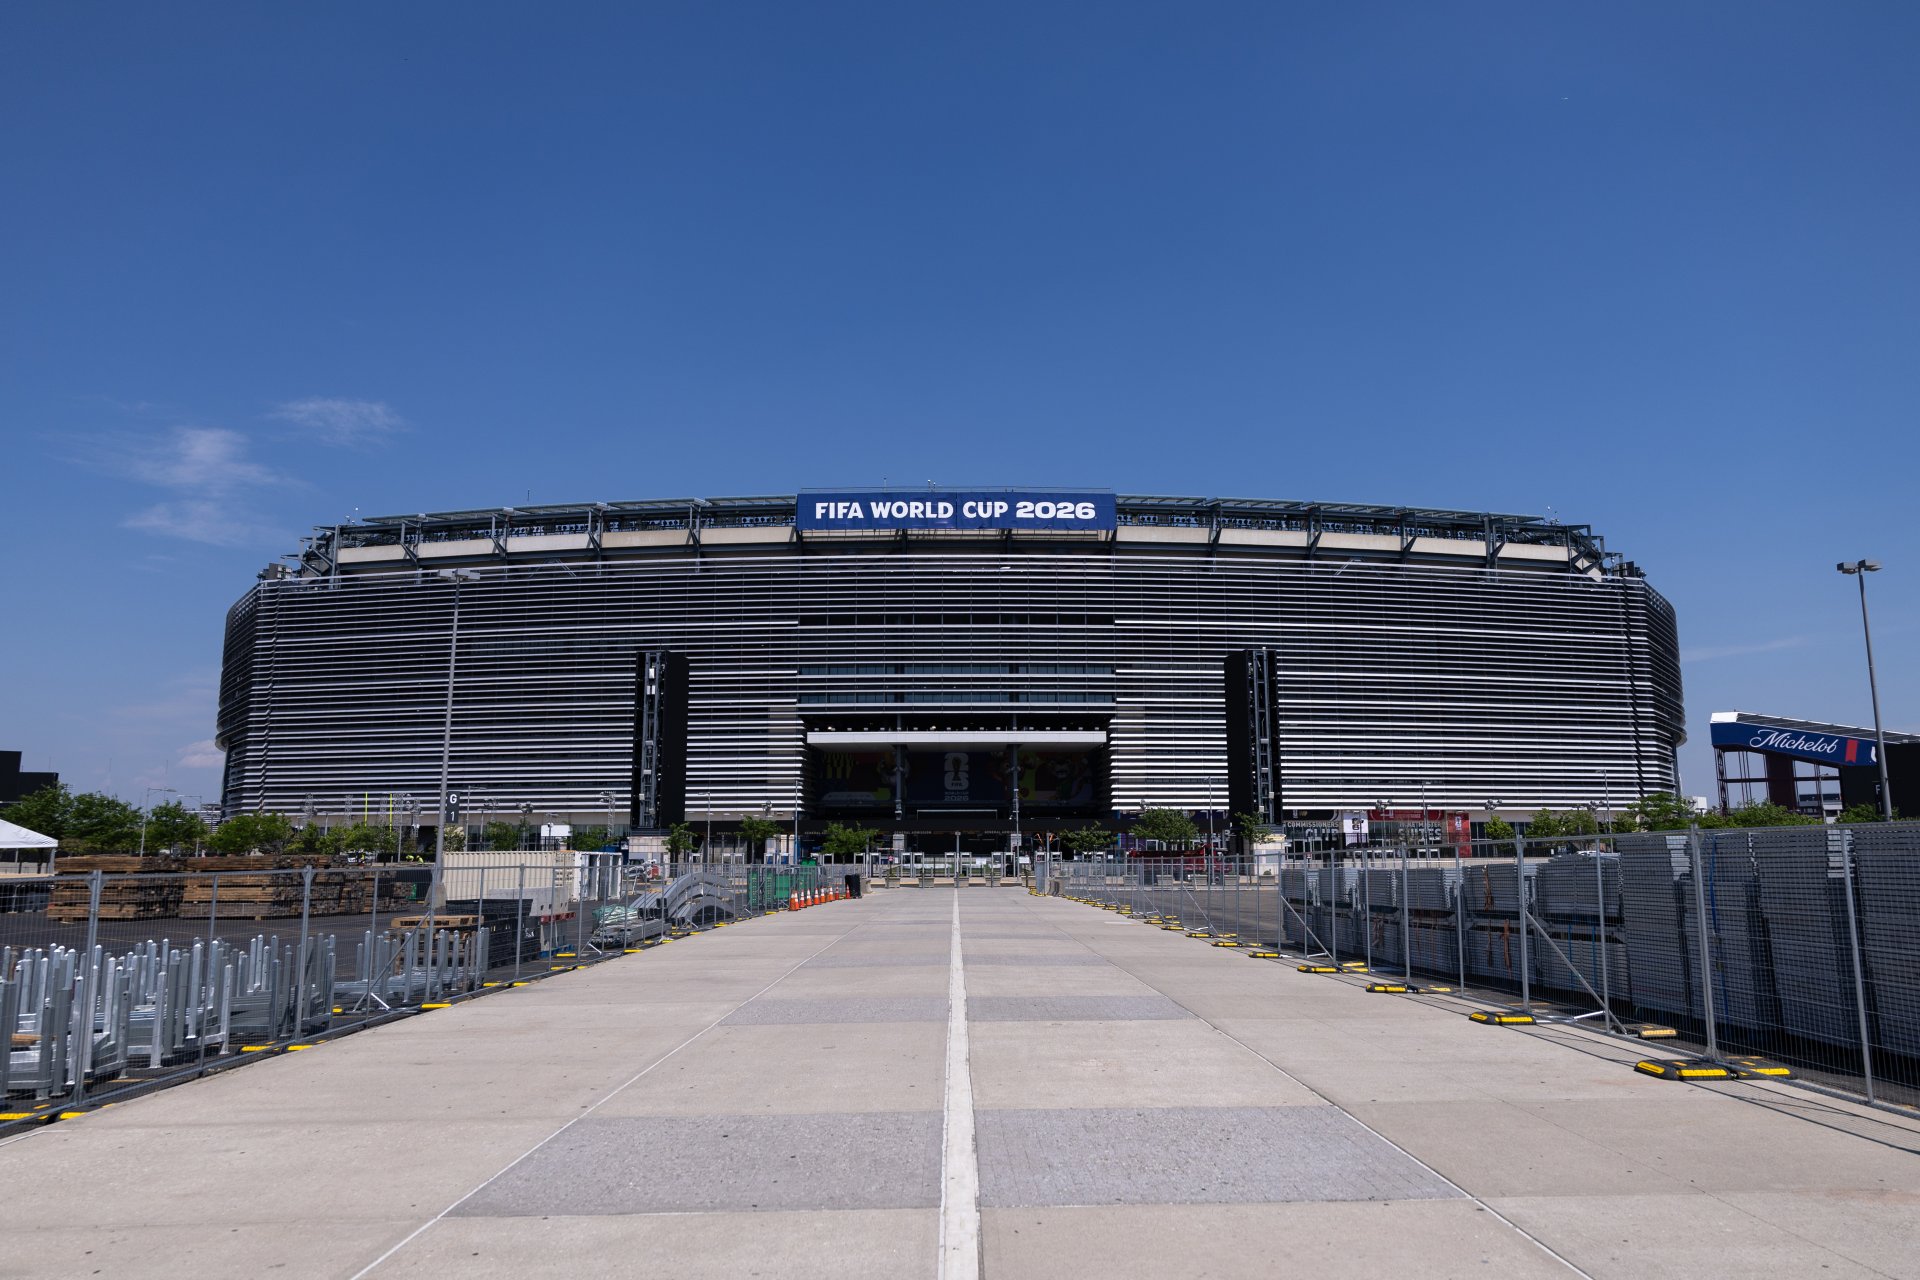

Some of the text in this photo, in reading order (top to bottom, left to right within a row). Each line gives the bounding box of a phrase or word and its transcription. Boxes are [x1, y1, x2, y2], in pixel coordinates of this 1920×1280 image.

[815, 501, 1096, 519] FIFA WORLD CUP 2026
[1749, 729, 1839, 754] Michelob
[449, 793, 458, 804] G
[450, 811, 455, 822] 1
